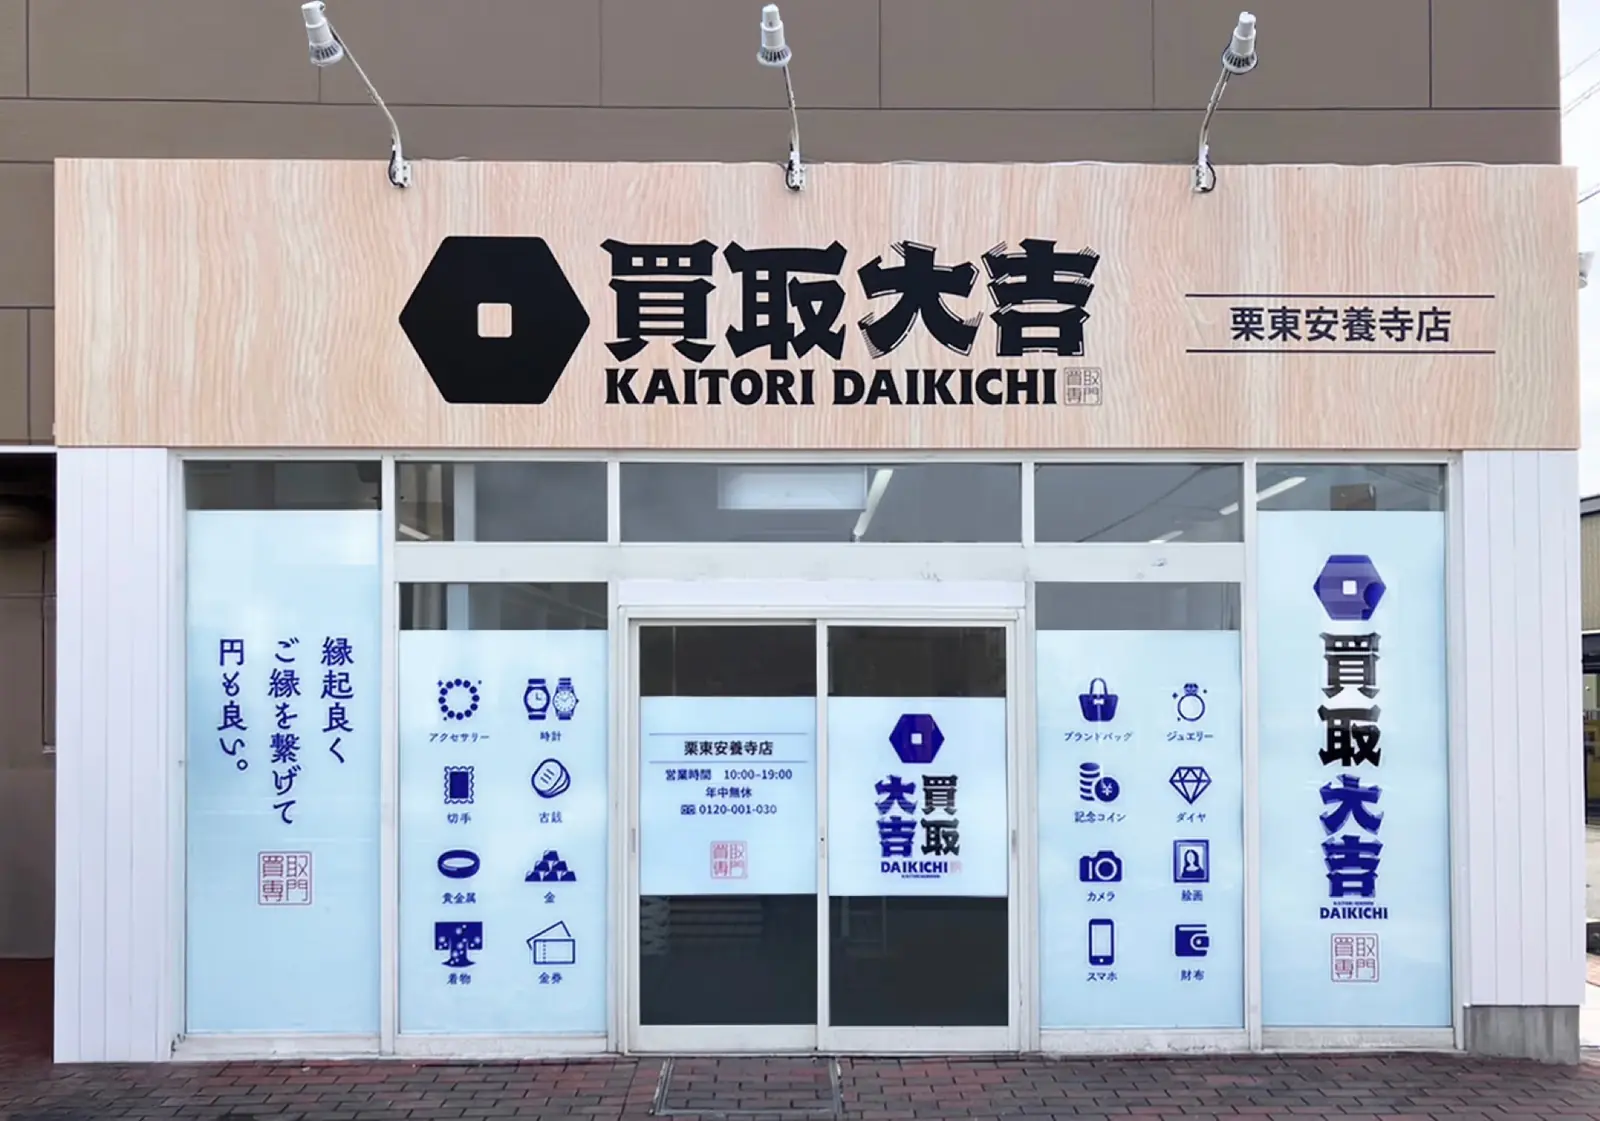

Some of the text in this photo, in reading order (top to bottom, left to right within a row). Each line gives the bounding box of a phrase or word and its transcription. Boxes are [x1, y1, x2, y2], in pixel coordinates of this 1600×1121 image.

[600, 238, 1100, 361] 買取大吉
[1229, 306, 1452, 343] 栗東安養寺店
[605, 368, 1057, 405] KAITORI DAIKICHI
[216, 638, 249, 771] 円も良い。
[320, 636, 355, 764] 縁起良く
[267, 637, 302, 825] ご縁を繋げて
[429, 732, 490, 743] アクセサリー
[539, 730, 562, 742] 時計
[1064, 730, 1133, 742] ブランドバッグ
[1166, 730, 1214, 743] ジュエリー
[684, 740, 774, 756] 栗東安養寺店
[1317, 632, 1385, 898] 買取大吉
[665, 769, 793, 781] 営業時間 10:00-19:00
[705, 786, 752, 799] 年中無休
[698, 804, 777, 815] 0120-001-030
[874, 774, 918, 858] 大吉
[920, 774, 960, 857] 買取
[446, 812, 472, 824] 切手
[1074, 810, 1126, 823] 記念コイン
[1176, 811, 1207, 823] ダイヤ
[880, 861, 948, 873] DAIKICHI
[543, 891, 556, 904] 金
[1087, 891, 1116, 902] カメラ
[1319, 907, 1388, 919] DAIKICHI
[1086, 971, 1118, 982] スマホ
